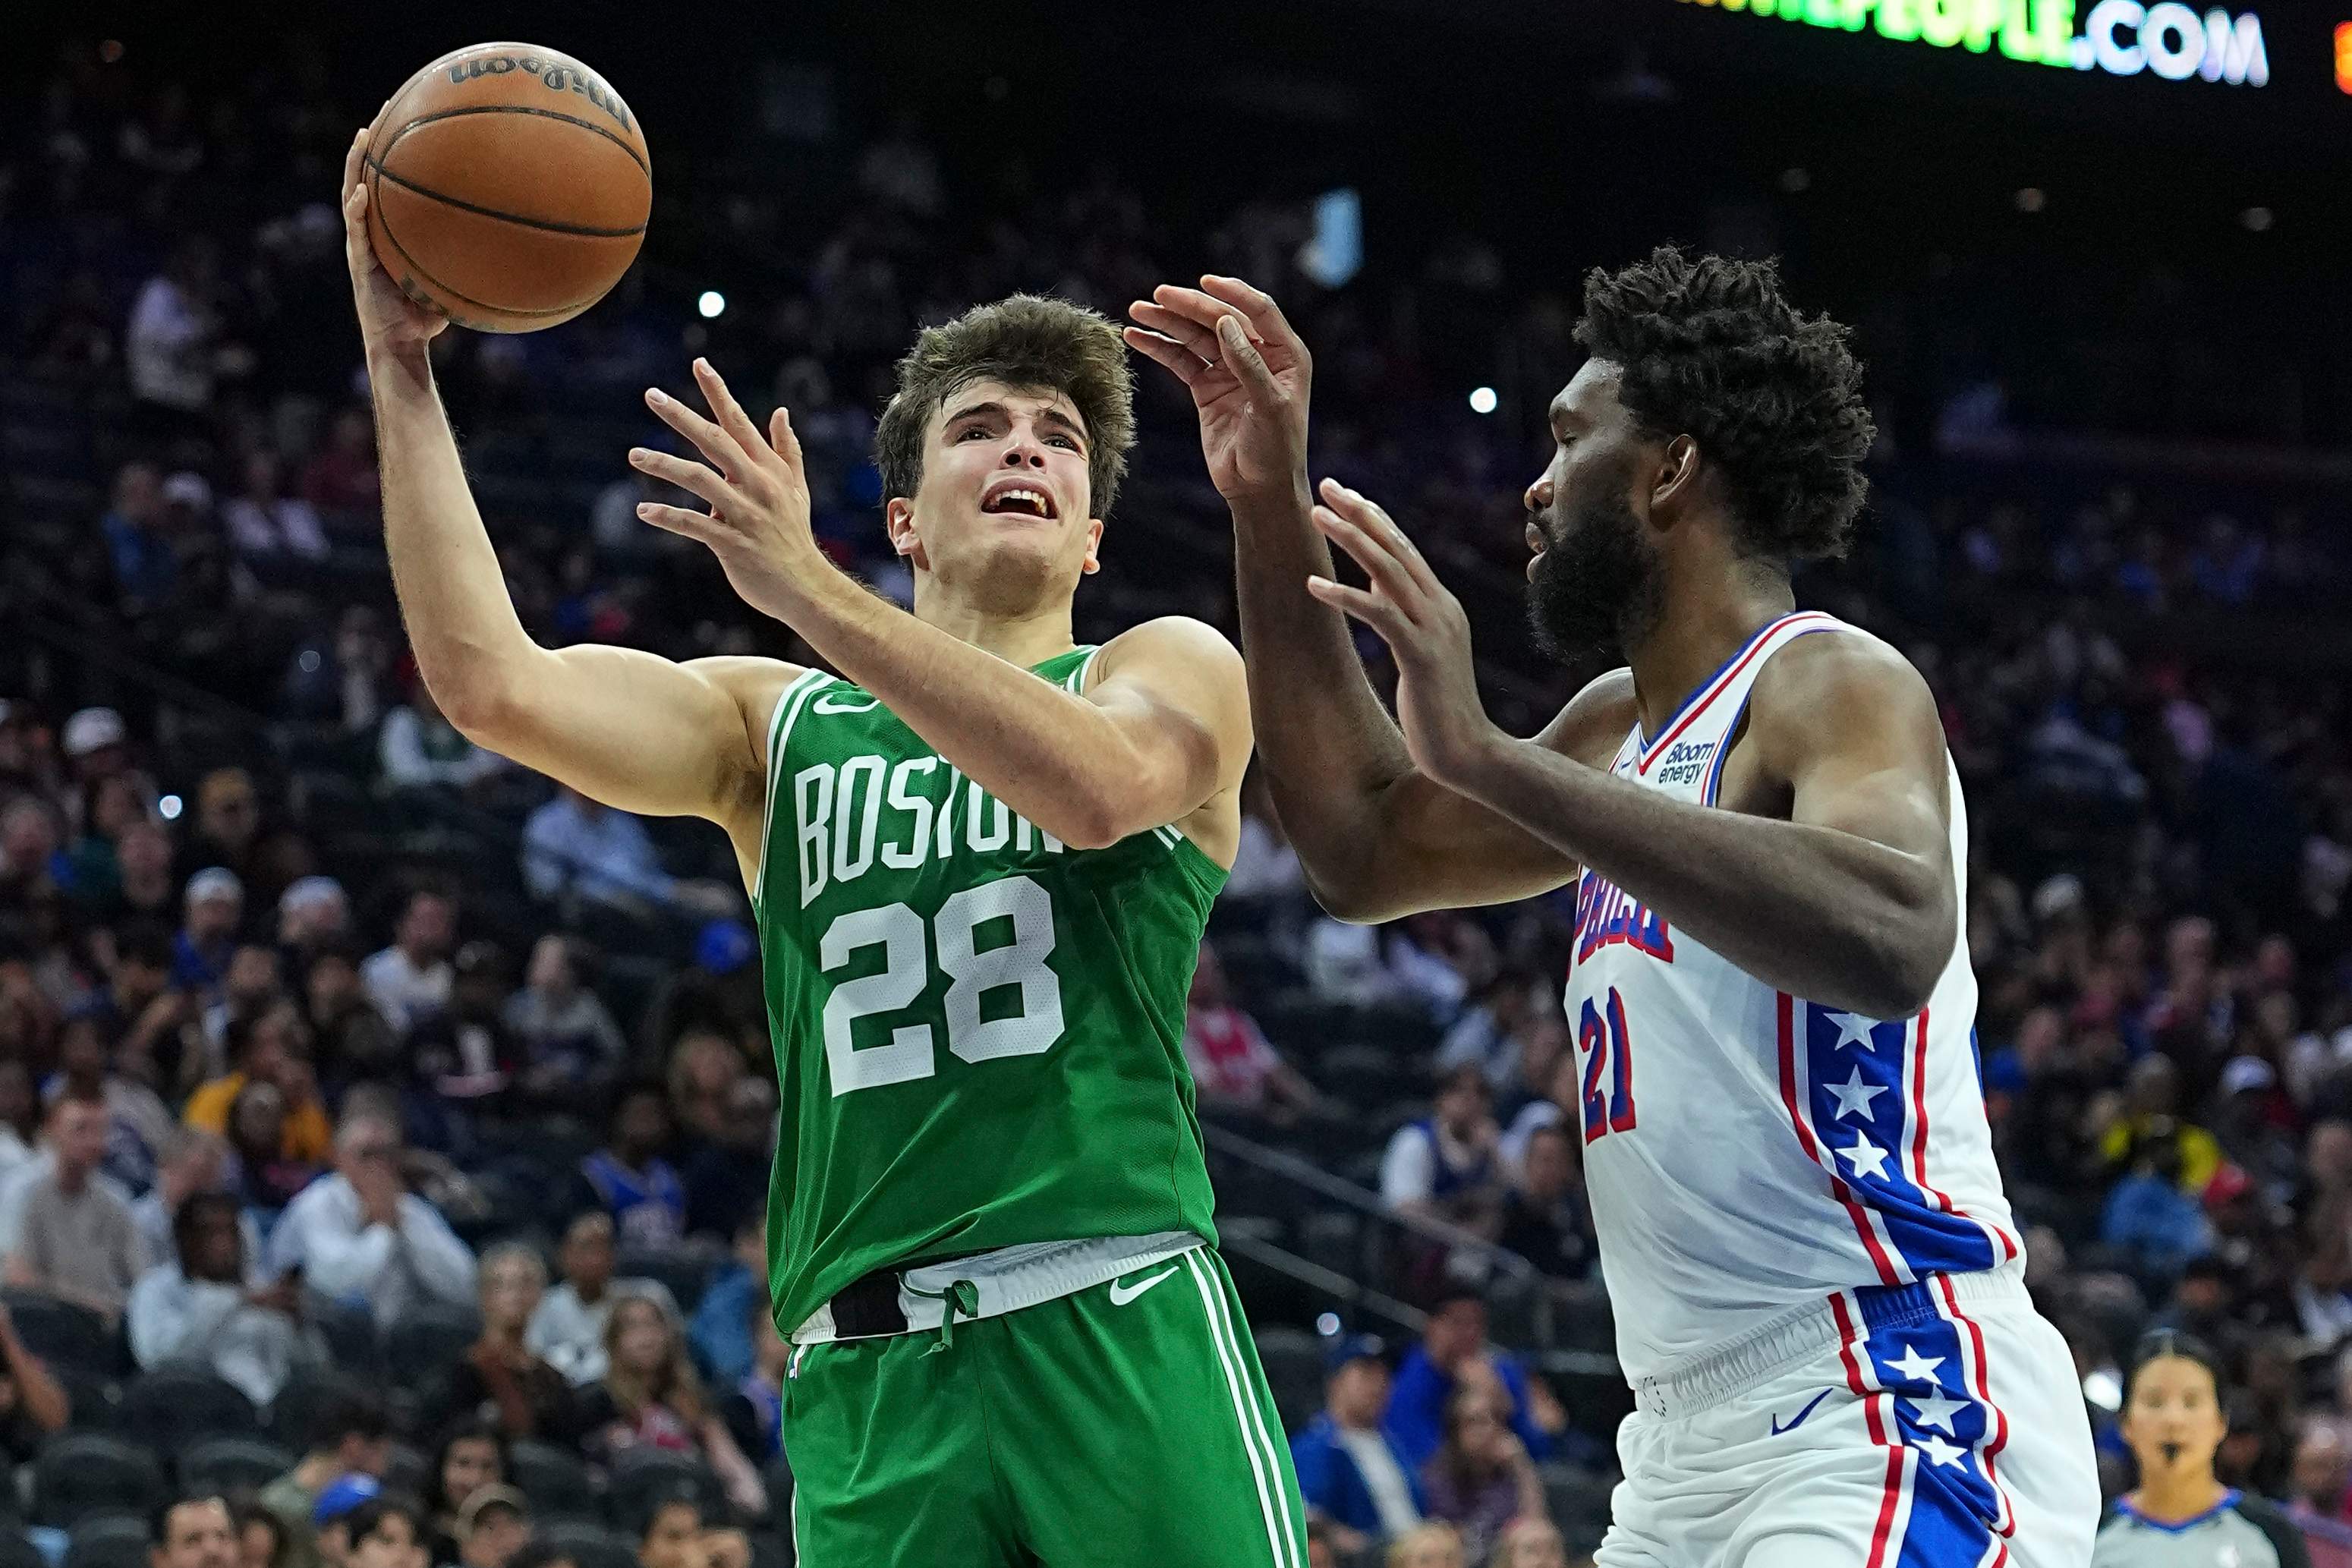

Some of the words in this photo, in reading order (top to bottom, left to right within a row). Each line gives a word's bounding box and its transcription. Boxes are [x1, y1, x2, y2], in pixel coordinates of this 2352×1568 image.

[1658, 763, 1706, 785] energy
[820, 876, 1065, 1098] 28
[1579, 985, 1636, 1146] 21
